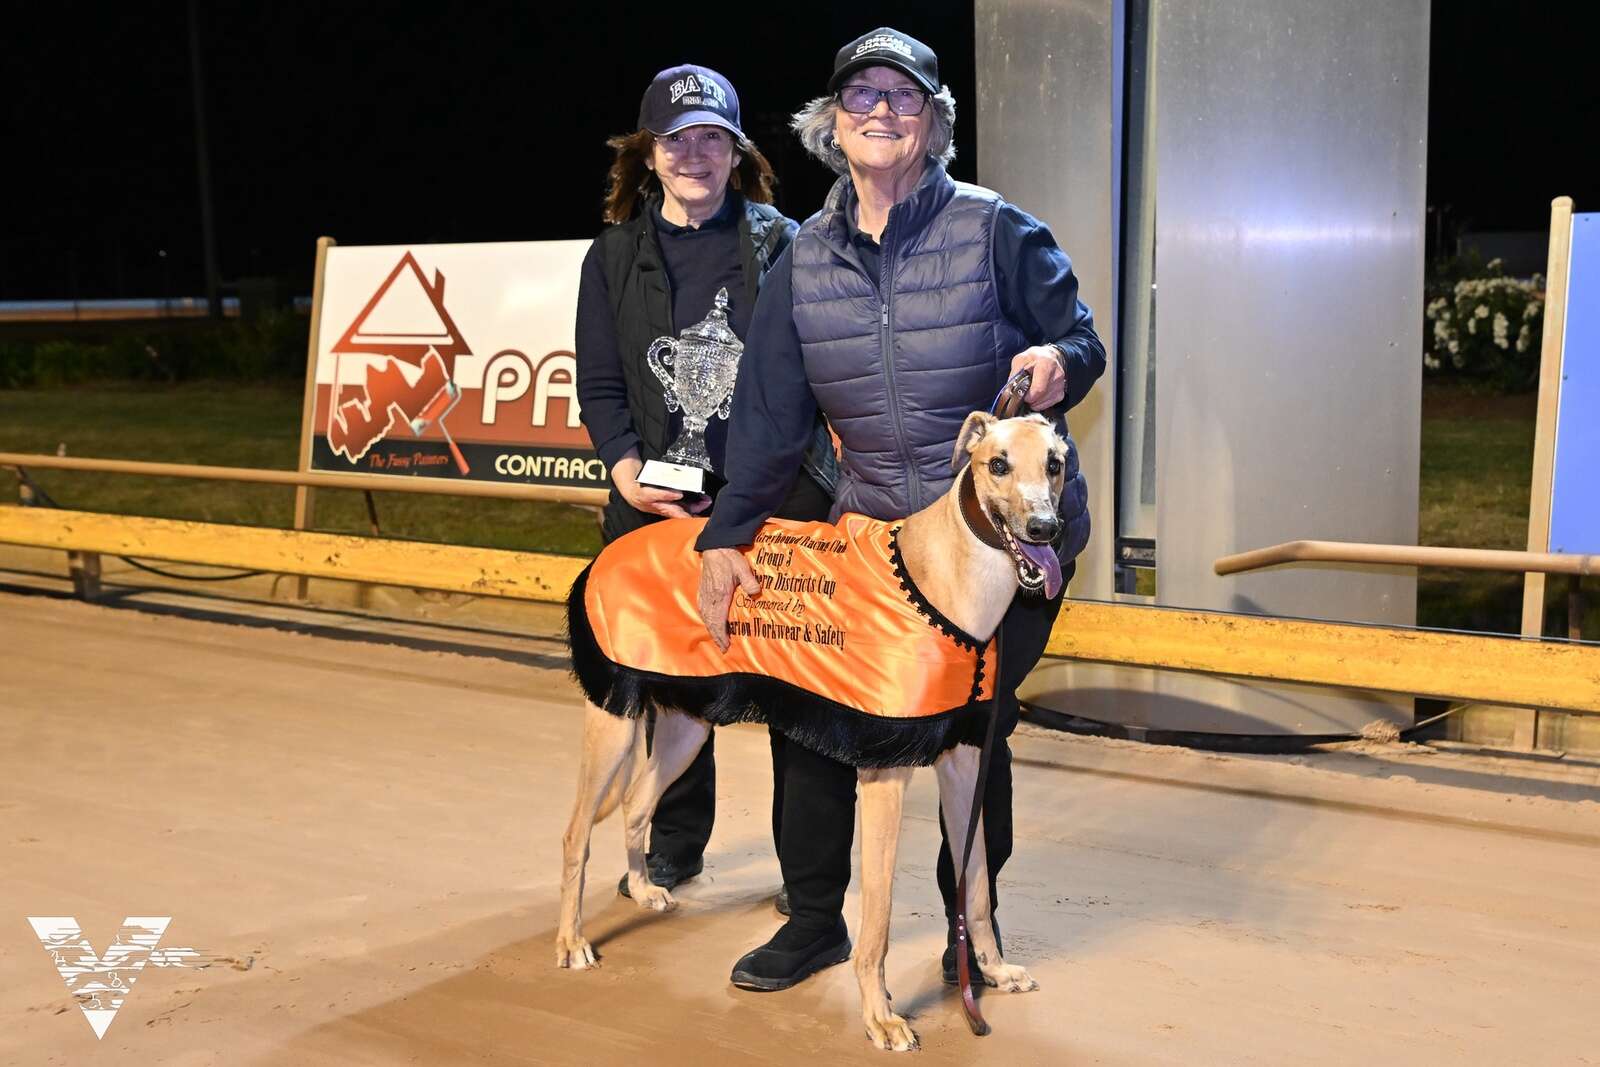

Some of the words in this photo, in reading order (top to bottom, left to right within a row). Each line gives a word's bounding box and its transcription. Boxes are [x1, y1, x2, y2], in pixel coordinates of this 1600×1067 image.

[670, 74, 728, 109] BATH
[481, 349, 580, 428] PA
[495, 454, 607, 481] CONTRACT
[800, 536, 830, 552] Racing
[829, 540, 847, 554] Club
[756, 548, 784, 571] Group
[786, 549, 793, 567] 3
[774, 572, 816, 593] Districts
[818, 575, 836, 599] Cup
[736, 593, 792, 612] Sponsored
[791, 599, 806, 617] by
[726, 620, 751, 637] arion
[753, 617, 801, 642] Workwear
[803, 623, 812, 643] &
[815, 623, 846, 651] Safety
